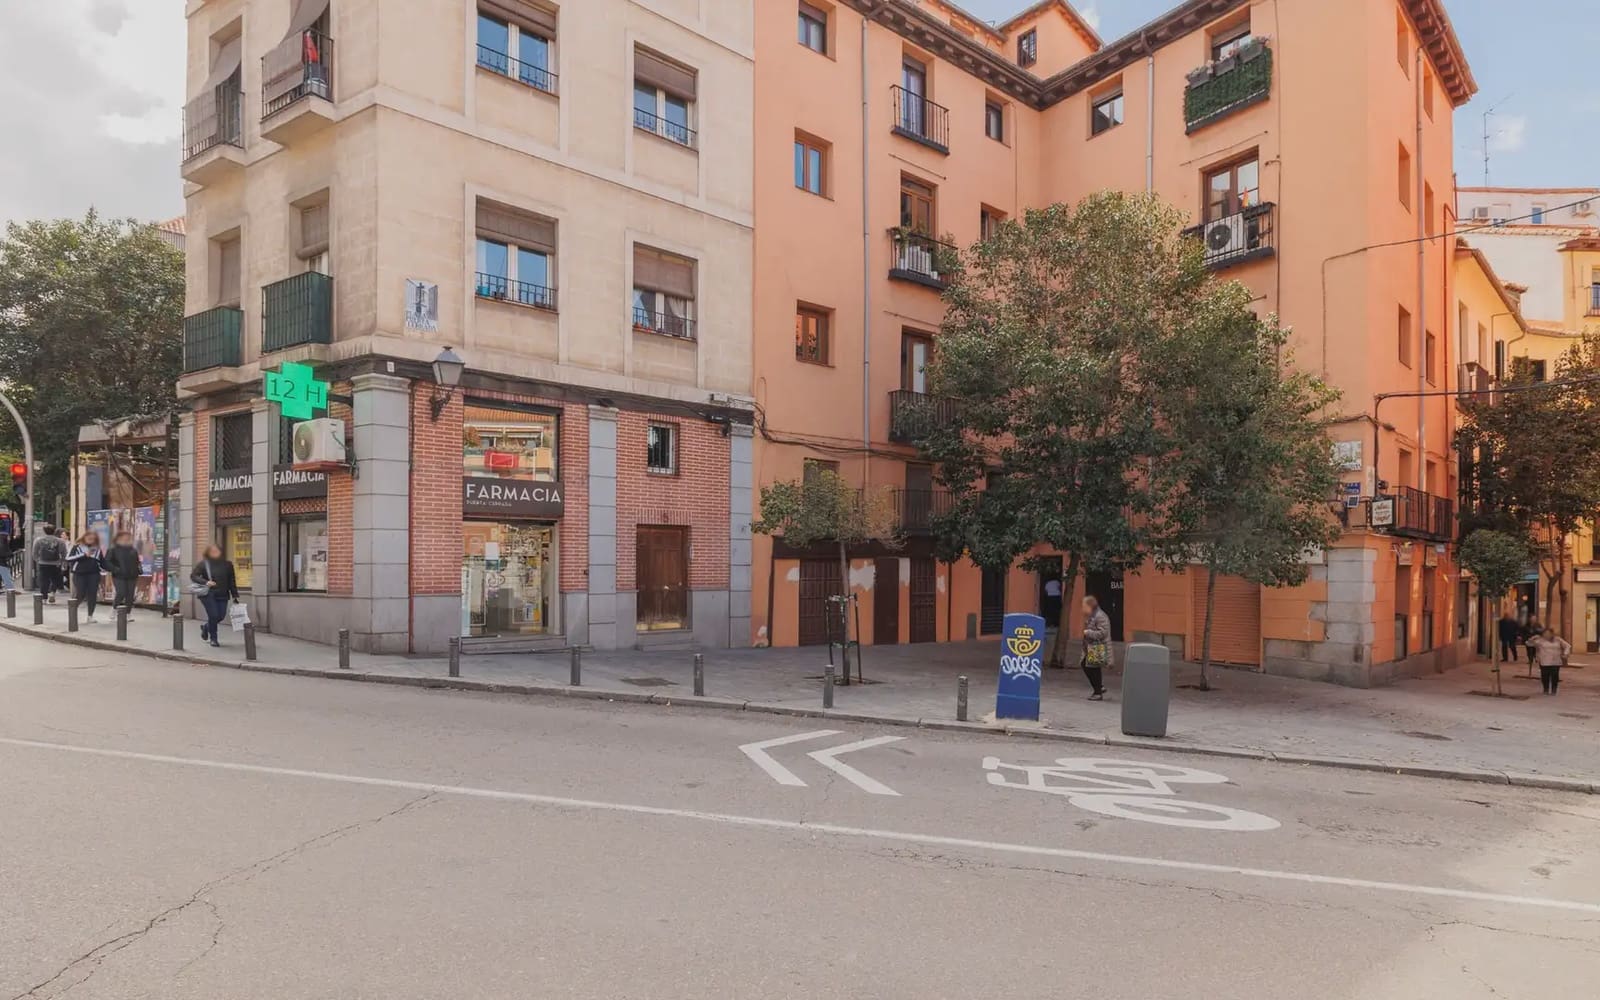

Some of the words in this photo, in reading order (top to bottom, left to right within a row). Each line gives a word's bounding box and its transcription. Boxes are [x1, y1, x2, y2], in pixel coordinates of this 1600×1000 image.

[270, 379, 297, 399] 12
[306, 384, 320, 403] H
[209, 474, 254, 492] FARMACIA
[273, 470, 325, 485] FARMACIA
[466, 483, 562, 503] FARMACIA
